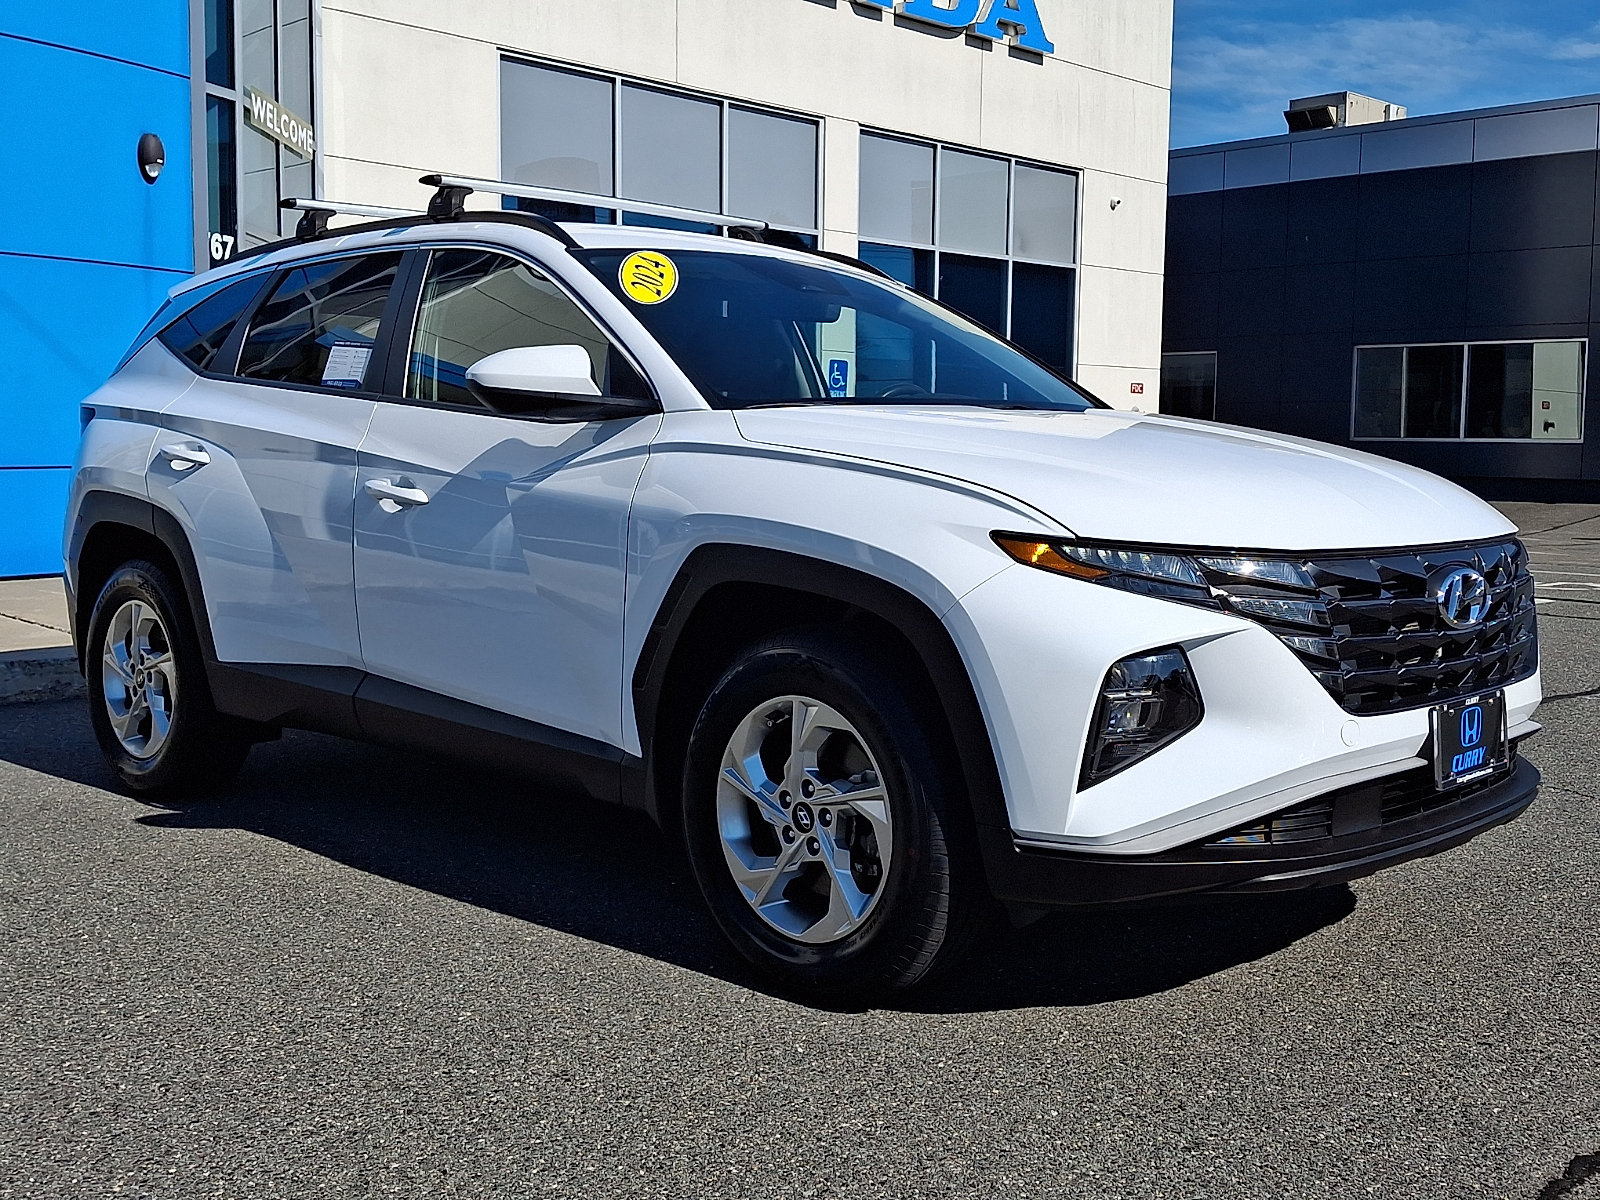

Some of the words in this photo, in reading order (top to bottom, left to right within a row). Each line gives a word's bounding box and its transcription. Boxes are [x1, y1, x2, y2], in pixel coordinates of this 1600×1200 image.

[251, 92, 313, 154] WELCOME
[208, 232, 235, 260] 67
[631, 254, 666, 297] 2024
[1451, 746, 1486, 773] CURRY
